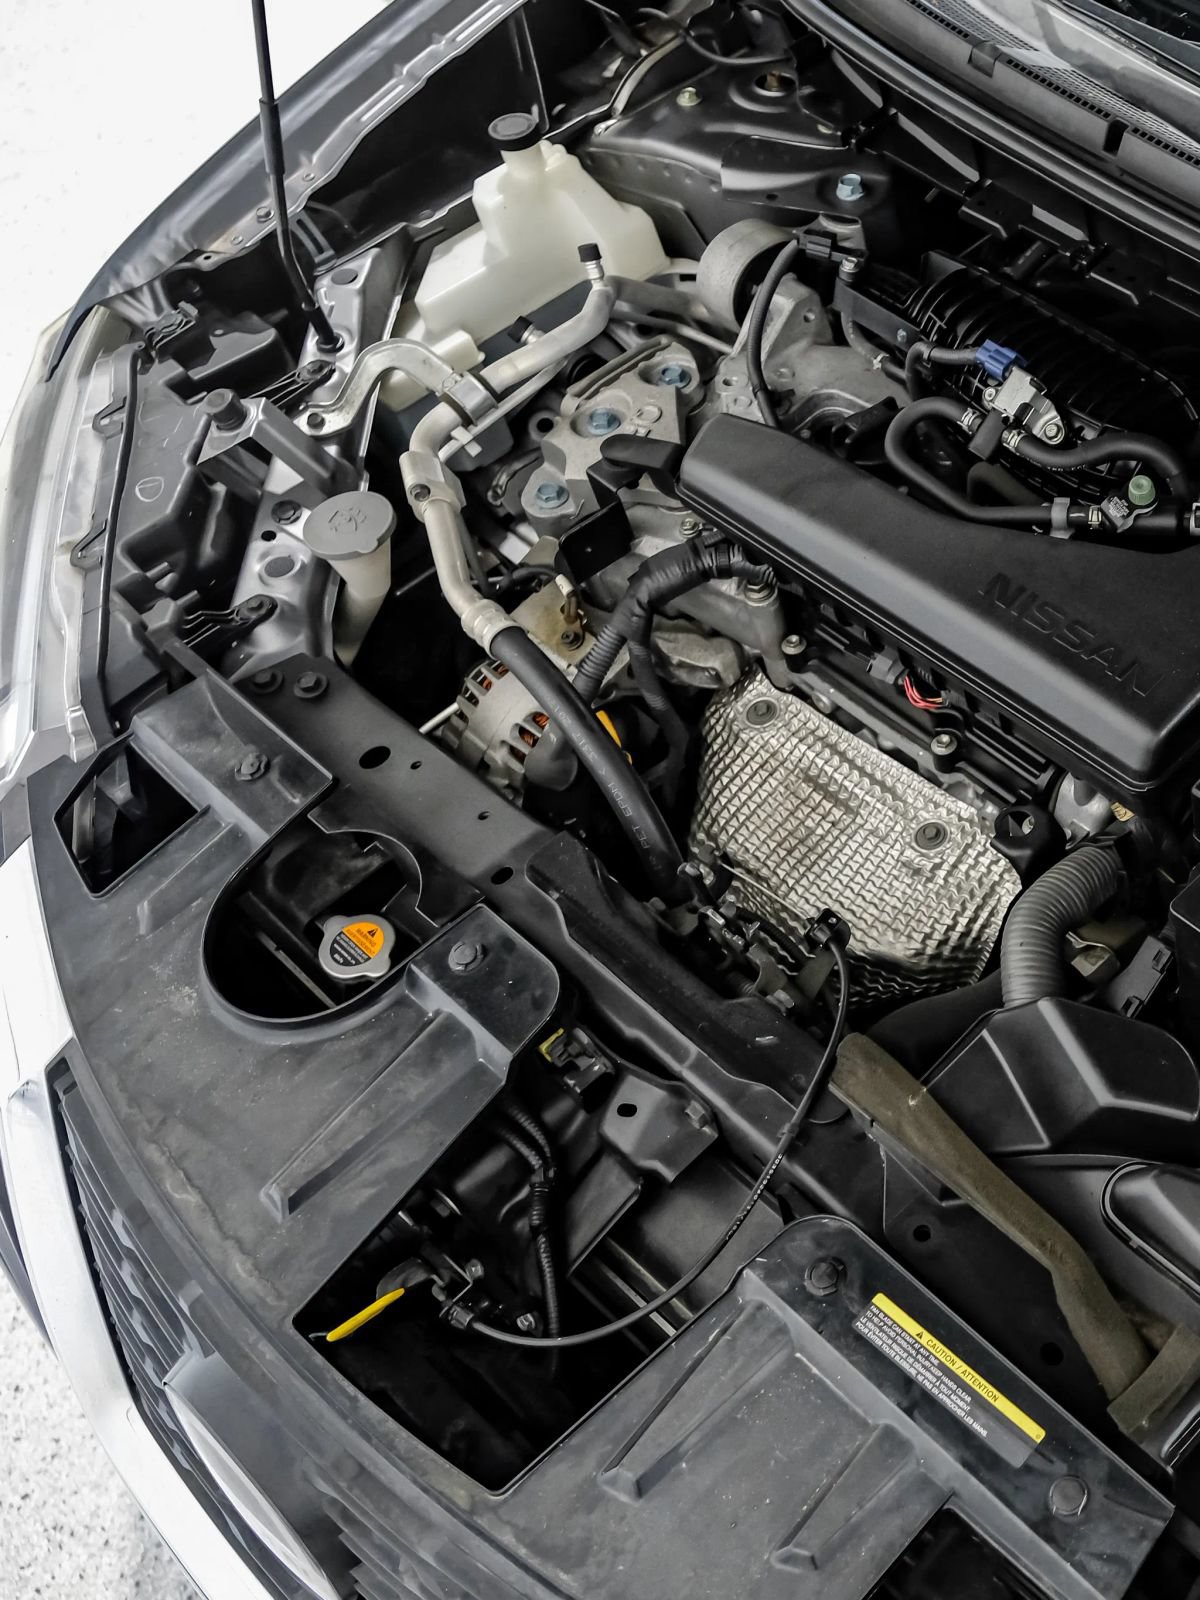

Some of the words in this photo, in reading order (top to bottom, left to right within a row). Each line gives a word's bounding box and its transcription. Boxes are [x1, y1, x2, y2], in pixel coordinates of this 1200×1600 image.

[978, 572, 1164, 696] NISSAN
[605, 780, 633, 817] EPDM
[865, 1310, 873, 1318] TO
[872, 1315, 884, 1326] HELP
[882, 1325, 896, 1338] AVOID
[895, 1335, 916, 1356] PERSONAL
[941, 1375, 957, 1390] HANDS
[866, 1321, 893, 1345] VENTILATEUR
[891, 1342, 908, 1358] RISQUE
[906, 1356, 914, 1364] DE
[912, 1361, 937, 1383] DÉMARRER
[939, 1383, 952, 1395] TOUT
[870, 1305, 880, 1315] FAN
[878, 1312, 893, 1326] BLADE
[891, 1324, 902, 1334] CAN
[901, 1331, 915, 1344] START
[919, 1347, 929, 1356] ANY
[855, 1321, 869, 1334] POUR
[867, 1330, 884, 1346] ÉVITER
[881, 1343, 896, 1357] TOUTE
[916, 1374, 925, 1382] NE
[922, 1379, 933, 1389] PAS
[931, 1386, 939, 1395] EN
[938, 1393, 965, 1417] APPROCHER
[963, 1414, 974, 1425] LES
[926, 1339, 957, 1366] CAUTION
[961, 1369, 999, 1402] ATTENTION
